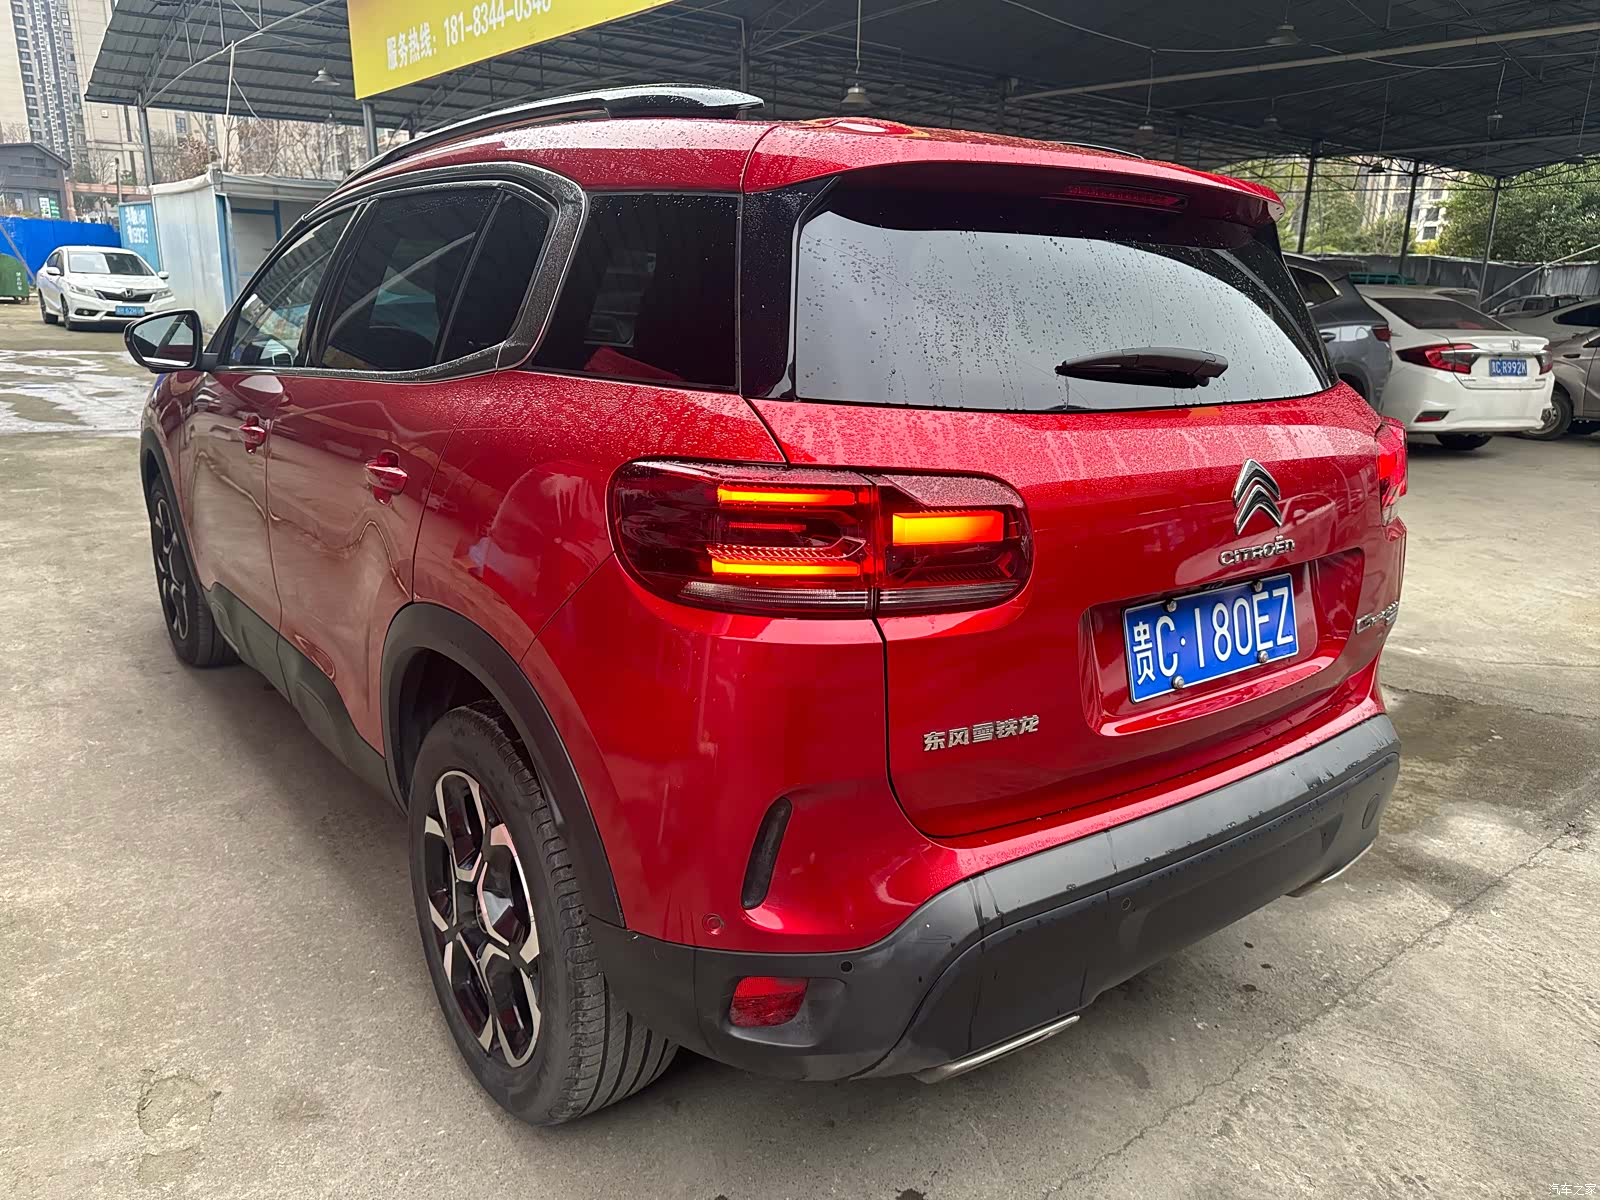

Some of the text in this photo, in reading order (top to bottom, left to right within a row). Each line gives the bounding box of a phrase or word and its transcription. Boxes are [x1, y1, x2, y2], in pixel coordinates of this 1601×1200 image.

[923, 714, 1040, 752] 东风雪铁龙
